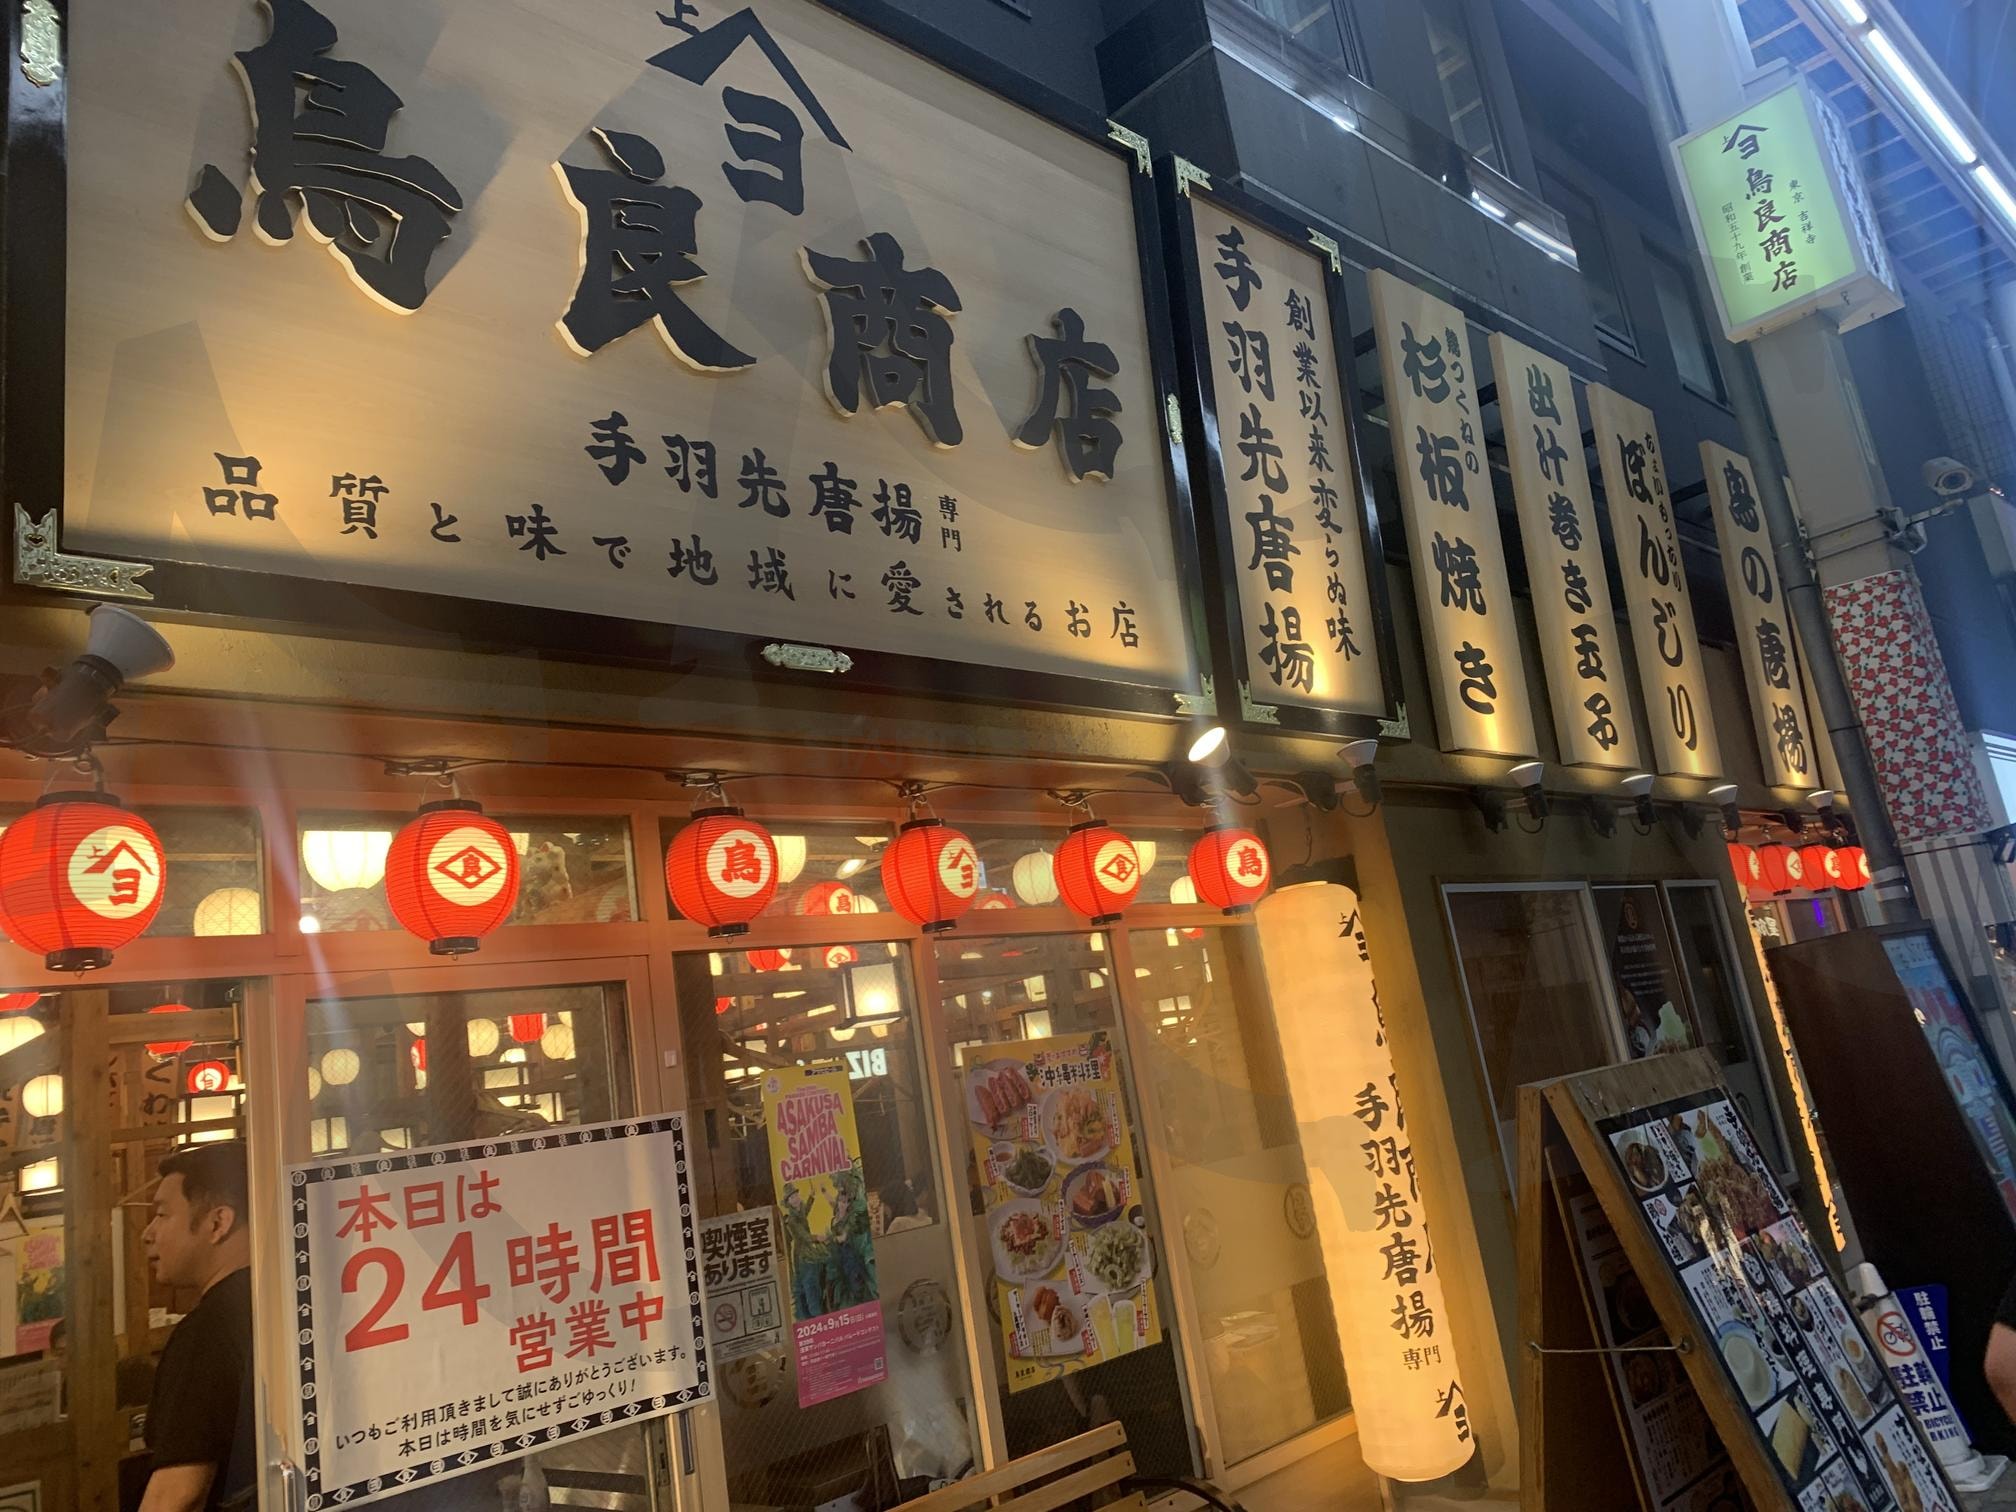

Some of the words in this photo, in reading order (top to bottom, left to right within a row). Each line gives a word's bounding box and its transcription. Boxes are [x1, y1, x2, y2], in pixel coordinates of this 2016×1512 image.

[185, 0, 1123, 483] 鳥良商店
[1745, 167, 1799, 293] 鳥良商店
[585, 410, 923, 546] 手羽先唐揚
[1213, 225, 1318, 695] 手羽先唐揚
[1284, 288, 1361, 662] 創業以来変らぬ味
[202, 452, 1141, 649] 品質と味で地域に愛されるお店
[938, 495, 963, 552] 専門
[1400, 320, 1498, 716] 杉板焼き
[1526, 363, 1620, 752] 出汁巻き玉子
[723, 838, 763, 885] 鳥
[1237, 845, 1261, 879] 鳥
[776, 1092, 845, 1136] ASAKUSA
[787, 1110, 838, 1162] SAMBA
[780, 1135, 852, 1182] CARNIVAL
[336, 1169, 503, 1243] 本日は
[701, 1217, 772, 1262] 喫煙室
[1354, 1083, 1435, 1341] 手羽先唐揚
[340, 1208, 663, 1354] 24時間
[704, 1250, 773, 1286] あります
[509, 1290, 666, 1375] 営業中
[1404, 1347, 1442, 1373] 専門
[1913, 1291, 1948, 1351] 駐輪禁止
[335, 1345, 690, 1448] いつもご利用頂きまして誠にありがとうございます。
[1903, 1386, 1947, 1417] 禁止
